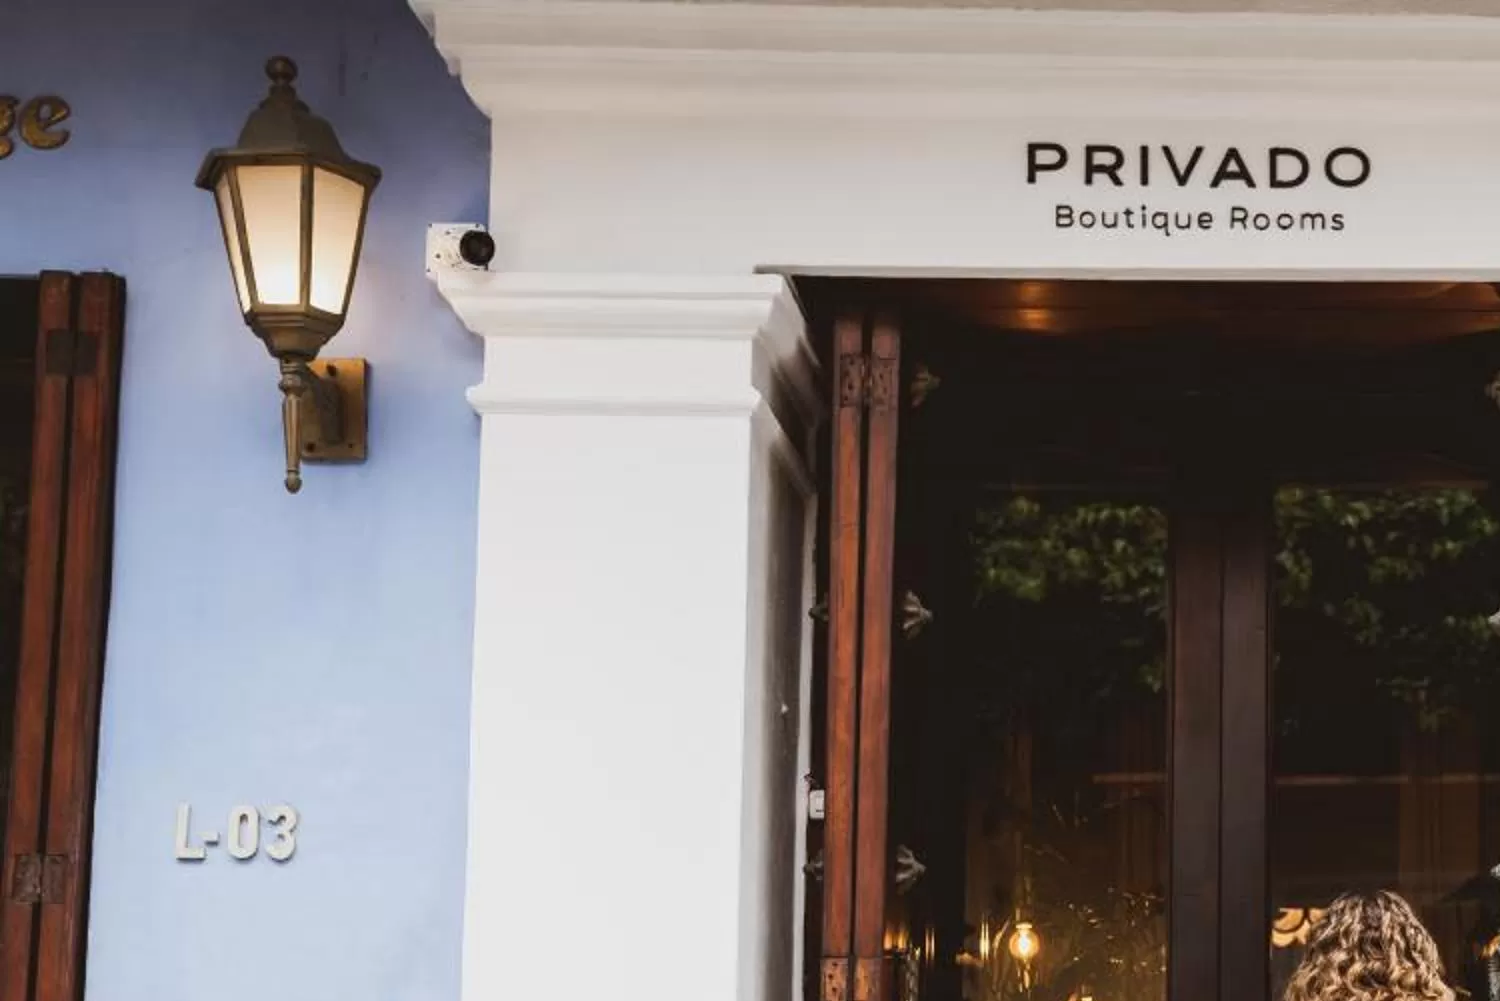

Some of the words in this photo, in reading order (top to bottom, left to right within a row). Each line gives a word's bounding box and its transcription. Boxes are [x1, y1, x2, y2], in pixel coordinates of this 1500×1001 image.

[1026, 142, 1371, 188] PRIVADO
[1054, 204, 1213, 236] Boutique
[1229, 206, 1345, 231] Rooms
[175, 802, 298, 862] L-03
